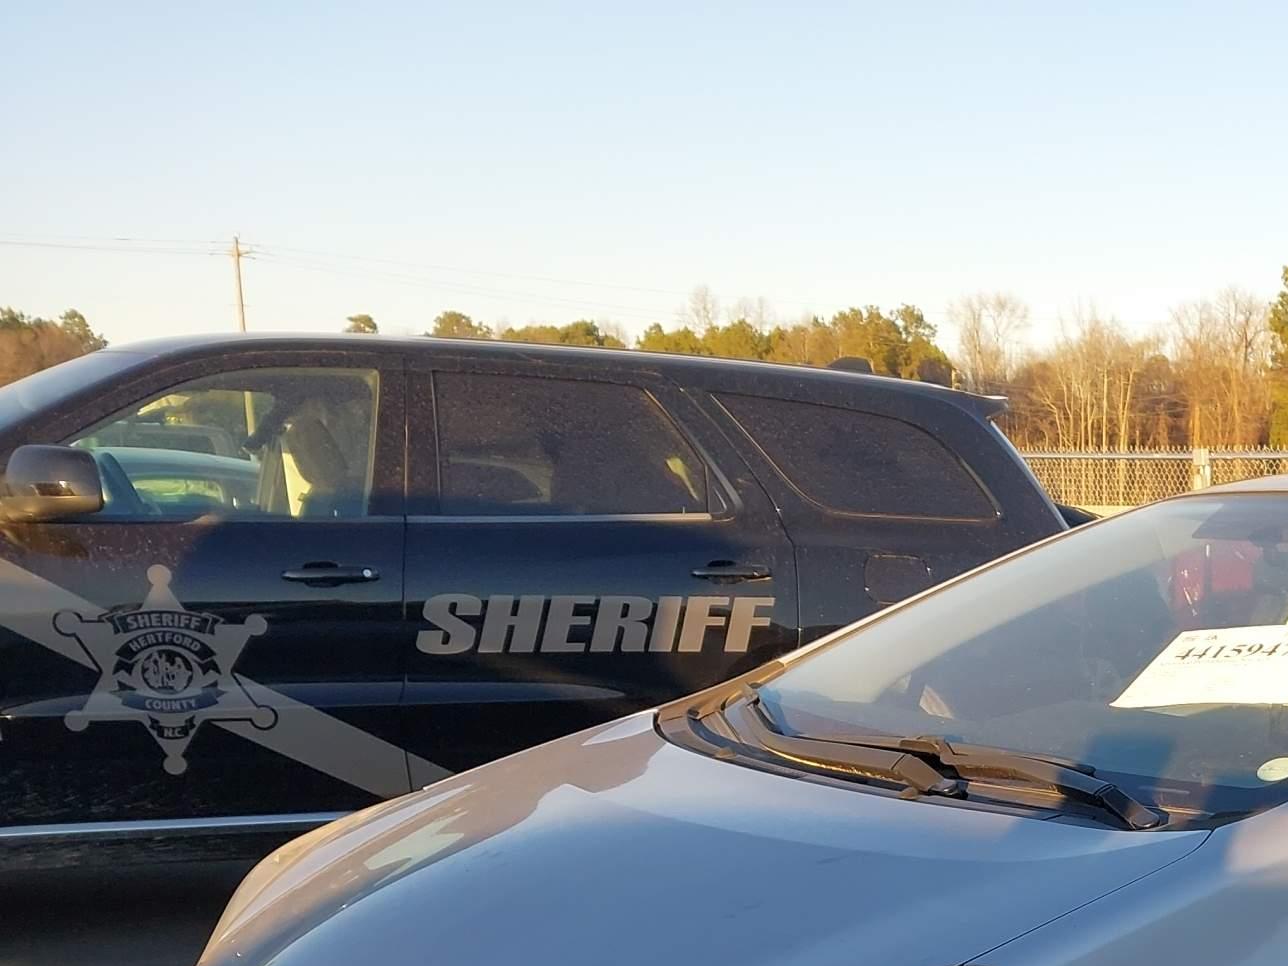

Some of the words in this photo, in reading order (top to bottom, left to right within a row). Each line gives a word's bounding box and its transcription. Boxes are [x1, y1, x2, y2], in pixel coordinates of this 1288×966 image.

[126, 613, 201, 630] SHERIFF
[416, 593, 776, 655] SHERIFF
[128, 631, 201, 652] HERTFORD
[144, 699, 196, 711] COUNTY
